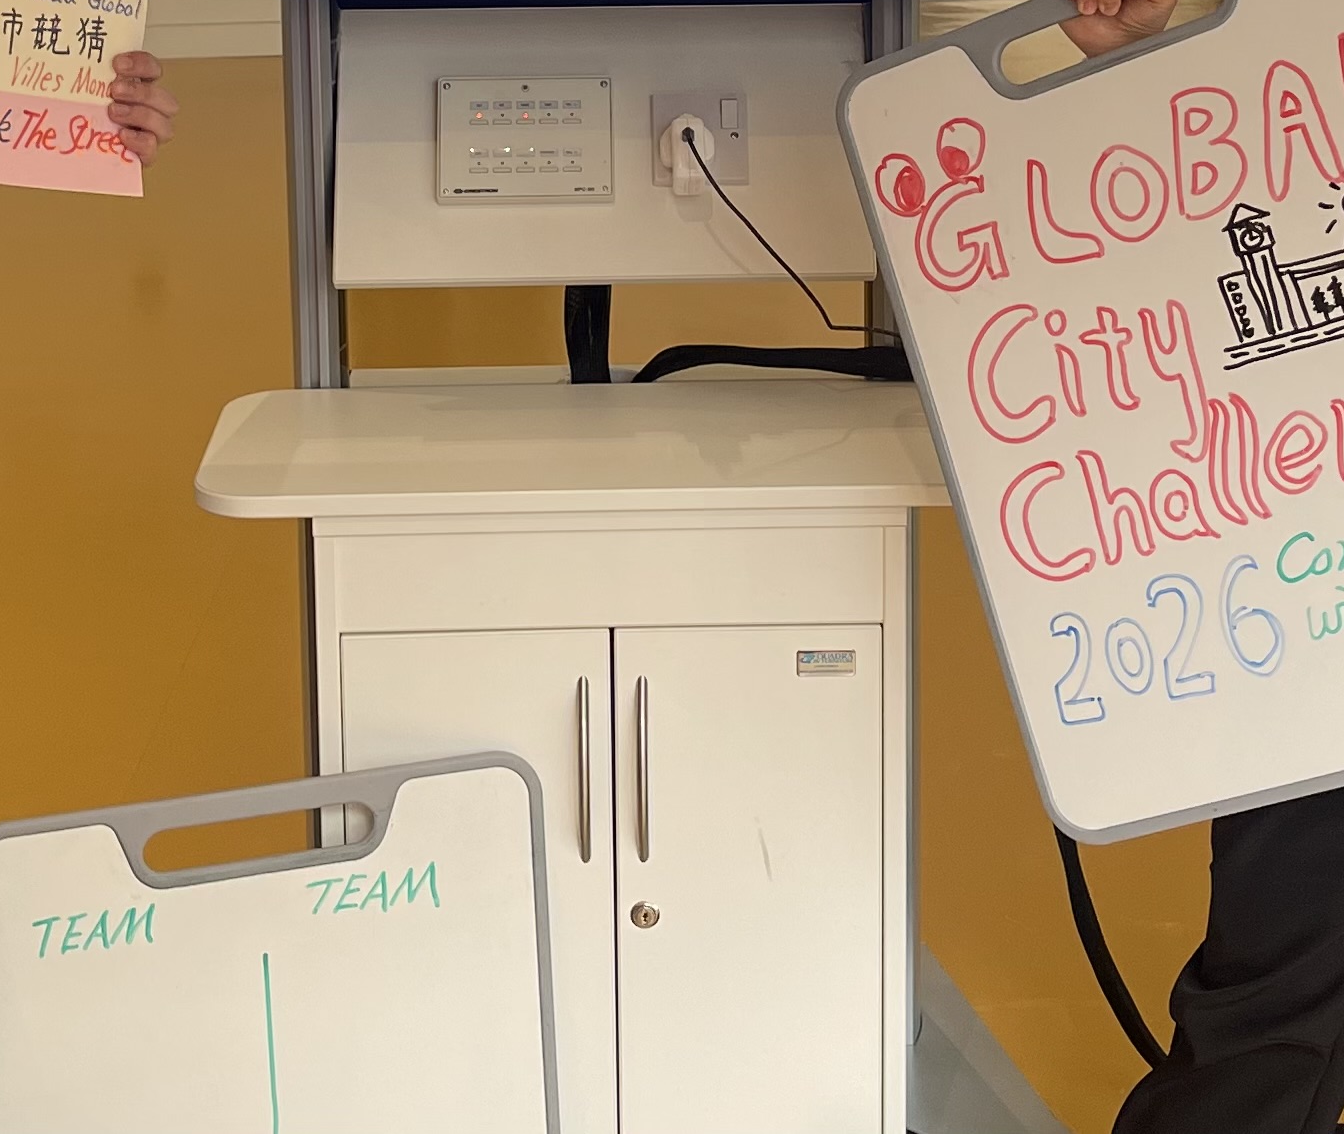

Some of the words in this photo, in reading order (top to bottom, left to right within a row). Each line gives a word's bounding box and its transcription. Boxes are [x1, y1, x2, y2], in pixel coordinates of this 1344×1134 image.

[10, 55, 64, 94] Villes
[12, 108, 57, 151] The
[967, 299, 1212, 461] City
[1050, 555, 1285, 726] 2026
[307, 861, 441, 914] TEAM
[32, 902, 156, 959] TEAM
